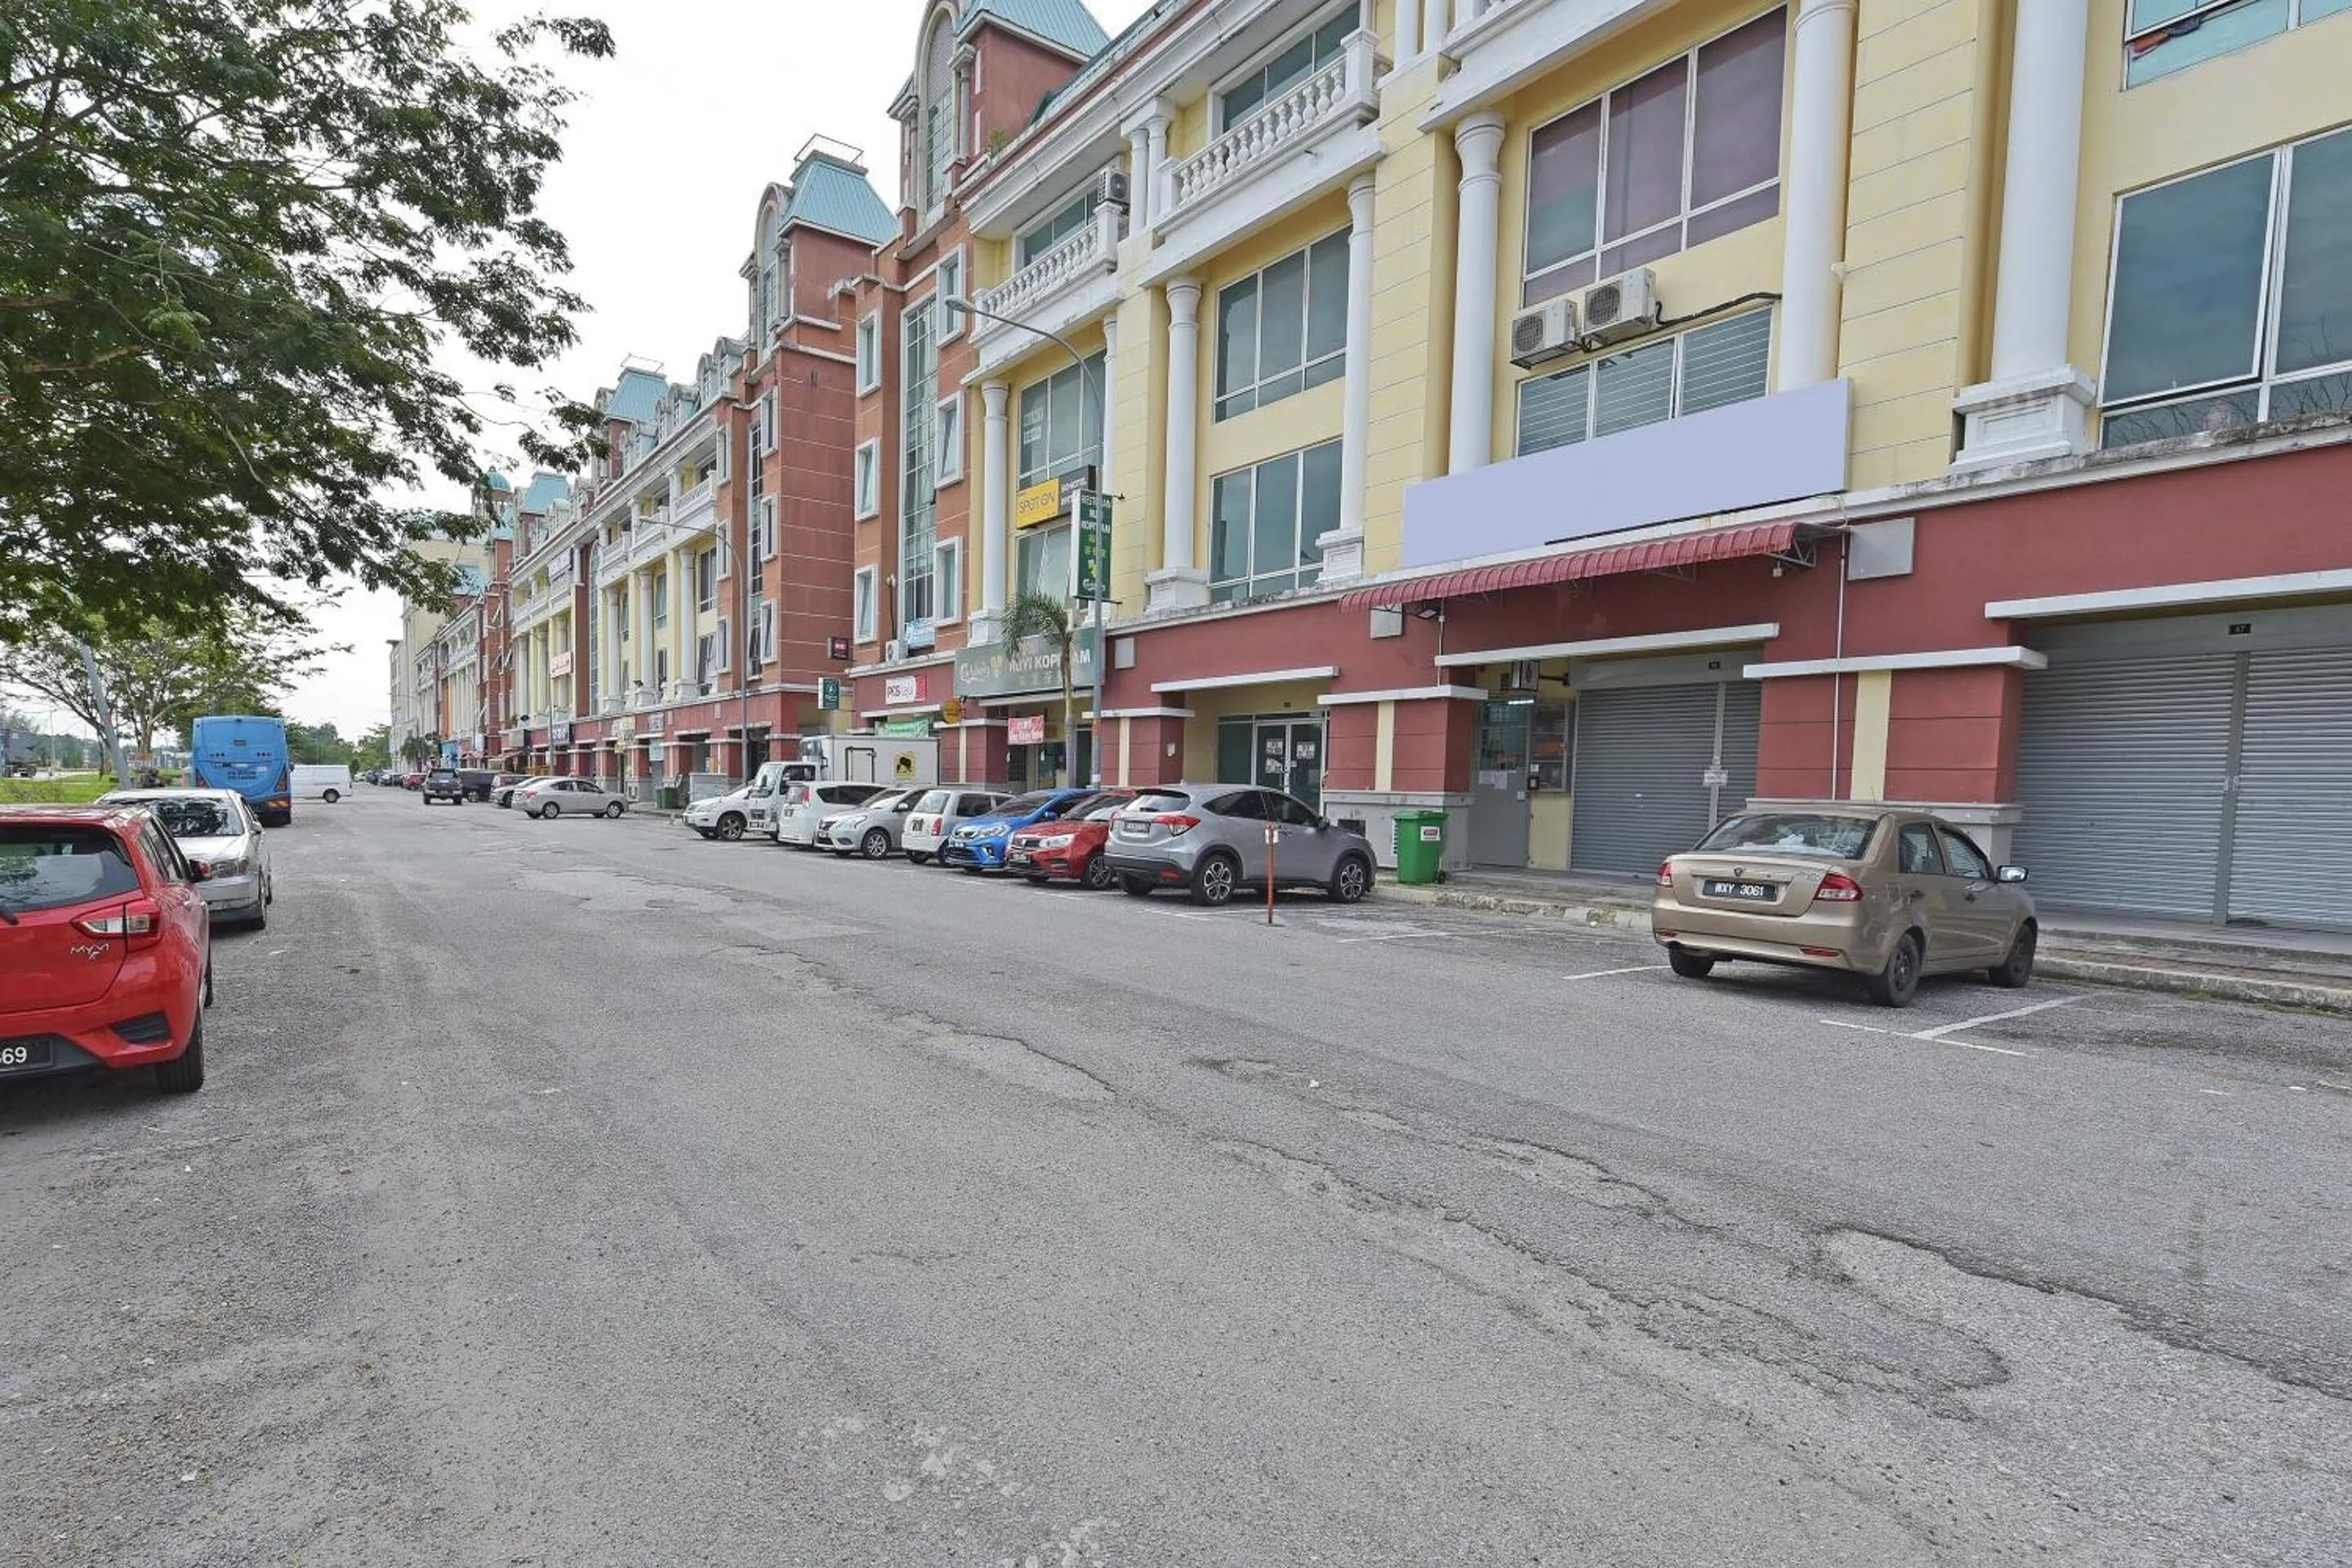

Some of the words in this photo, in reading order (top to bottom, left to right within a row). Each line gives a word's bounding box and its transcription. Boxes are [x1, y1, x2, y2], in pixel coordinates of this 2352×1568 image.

[1019, 496, 1040, 514] SPOT
[1040, 492, 1055, 504] ON
[1035, 648, 1090, 670] KOPIAM
[887, 684, 901, 697] POS
[1740, 884, 1764, 896] 3061
[0, 1046, 28, 1065] 69
